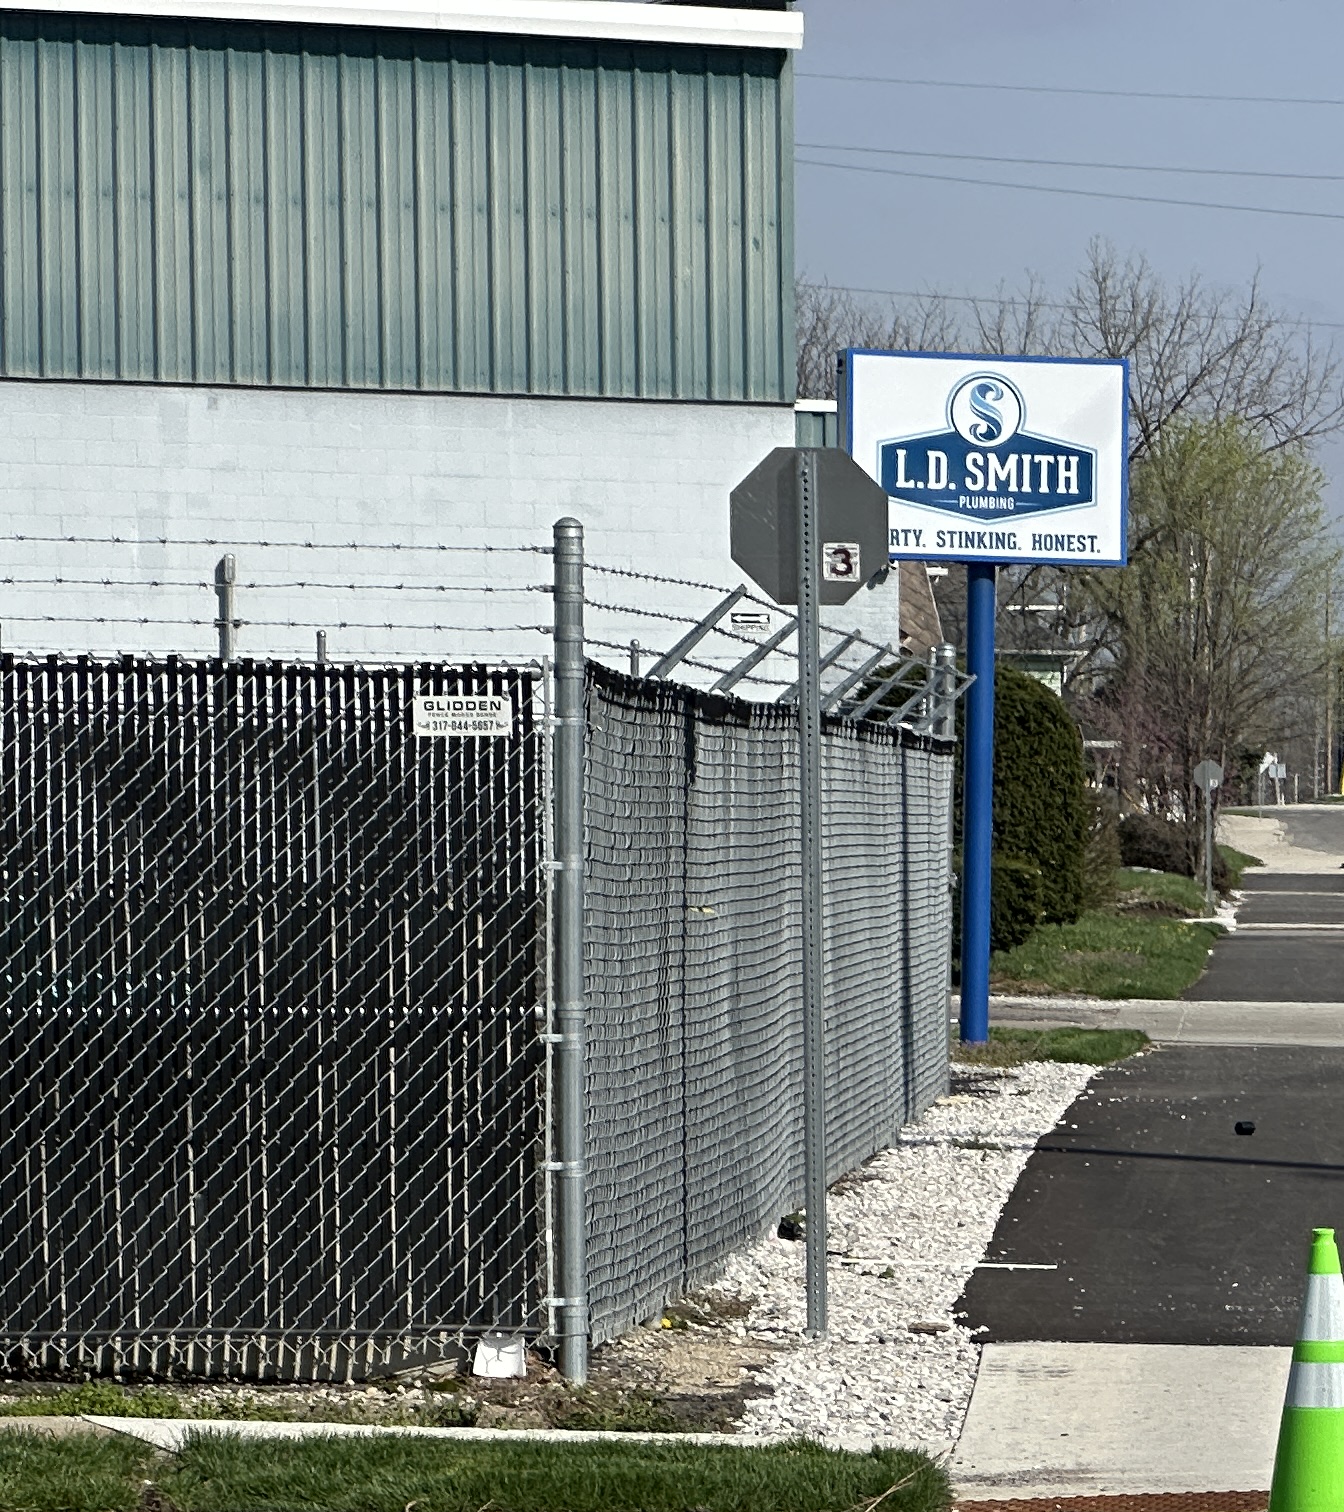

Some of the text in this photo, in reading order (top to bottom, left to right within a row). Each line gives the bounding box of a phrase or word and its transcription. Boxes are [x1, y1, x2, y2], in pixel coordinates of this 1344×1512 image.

[896, 449, 1080, 494] L.D. SMITH
[959, 496, 1015, 510] PLUMBING
[890, 528, 1101, 553] RTY. STINKING. HONEST.
[831, 548, 853, 575] 3
[424, 701, 501, 711] GLIDDEN
